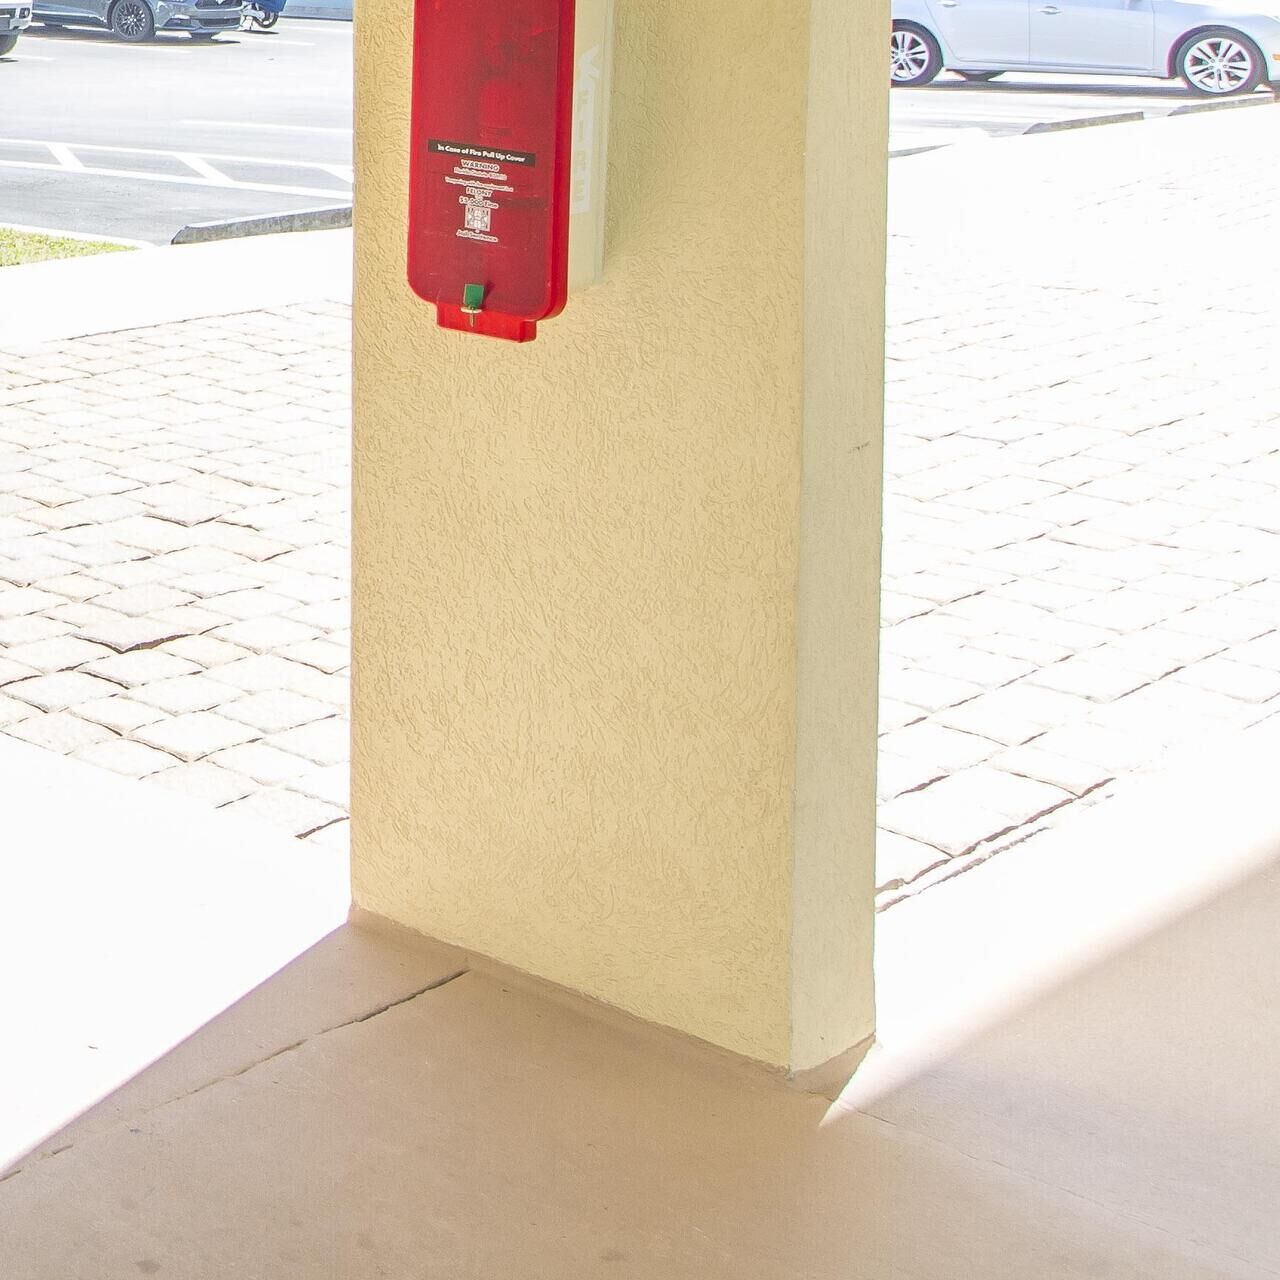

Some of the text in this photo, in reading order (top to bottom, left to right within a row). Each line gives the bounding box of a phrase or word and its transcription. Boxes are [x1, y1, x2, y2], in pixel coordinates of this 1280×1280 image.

[437, 143, 444, 151] In
[445, 145, 460, 153] Case
[469, 148, 481, 156] Fire
[483, 150, 494, 158] Pull
[495, 152, 505, 160] Up
[506, 154, 526, 163] Cover
[461, 160, 499, 171] WARNING
